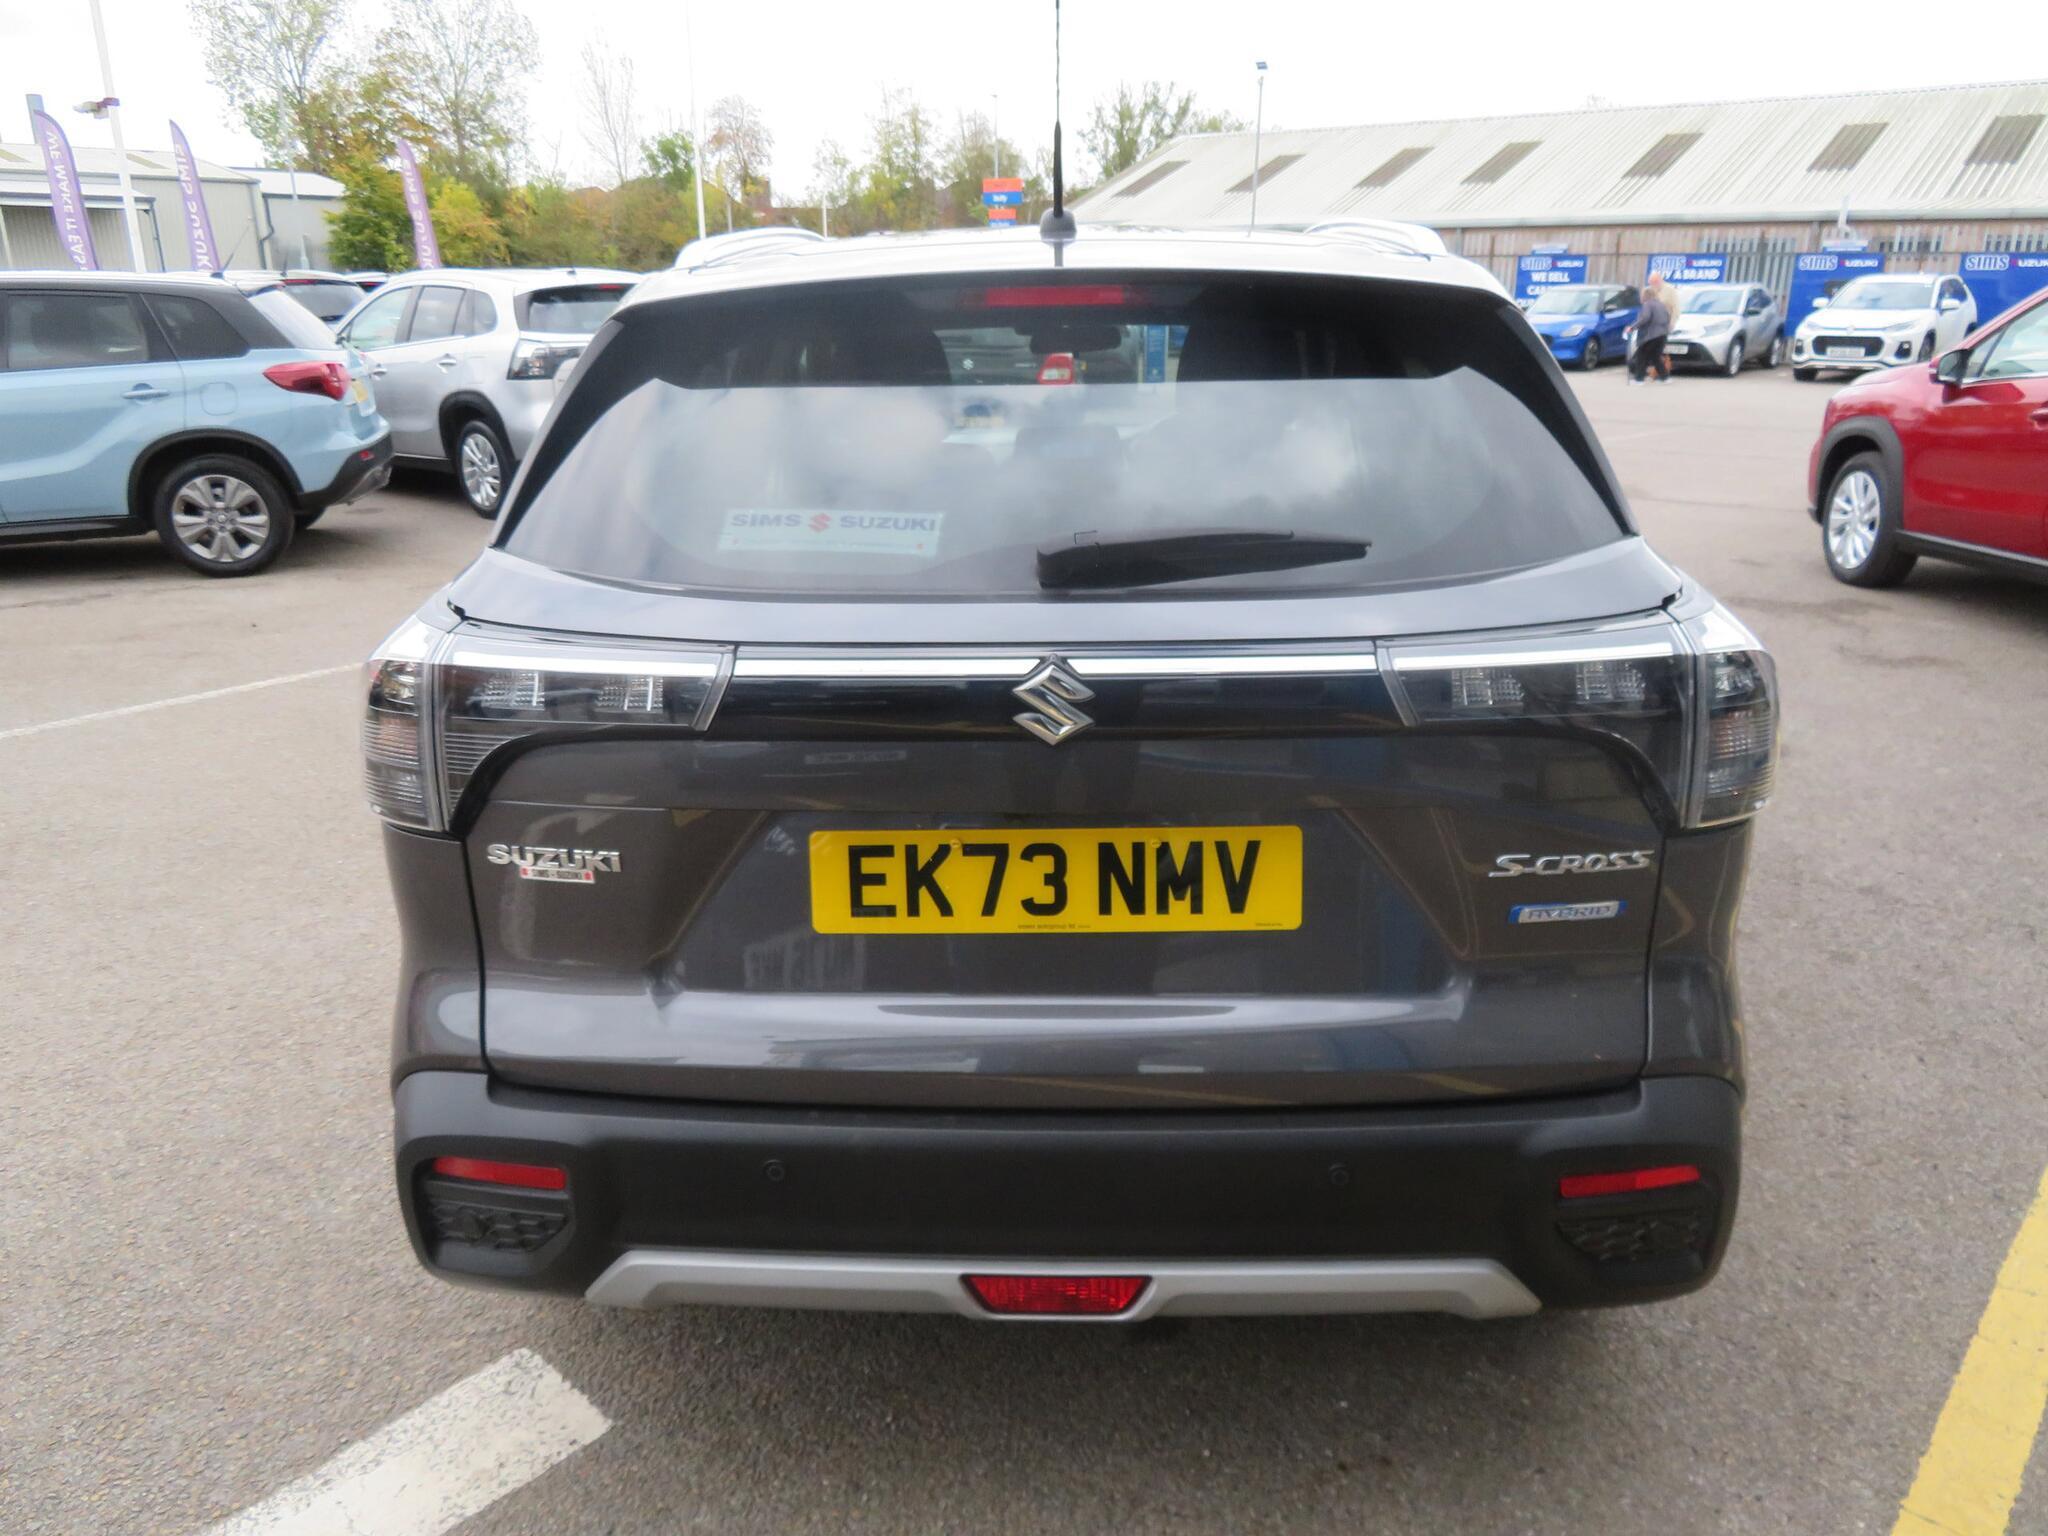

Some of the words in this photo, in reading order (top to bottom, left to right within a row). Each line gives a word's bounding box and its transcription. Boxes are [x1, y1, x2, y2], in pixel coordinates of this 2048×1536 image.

[1531, 271, 1547, 283] WE
[1548, 272, 1570, 283] SELL
[1683, 268, 1720, 280] BRAND
[731, 513, 801, 527] SIMS
[840, 515, 936, 532] SUZUKI
[486, 843, 622, 873] SUZUKI
[1488, 850, 1655, 878] S-CROSS
[847, 842, 1068, 918] EK73
[1097, 840, 1262, 915] NMV
[1528, 905, 1611, 920] HYBRID
